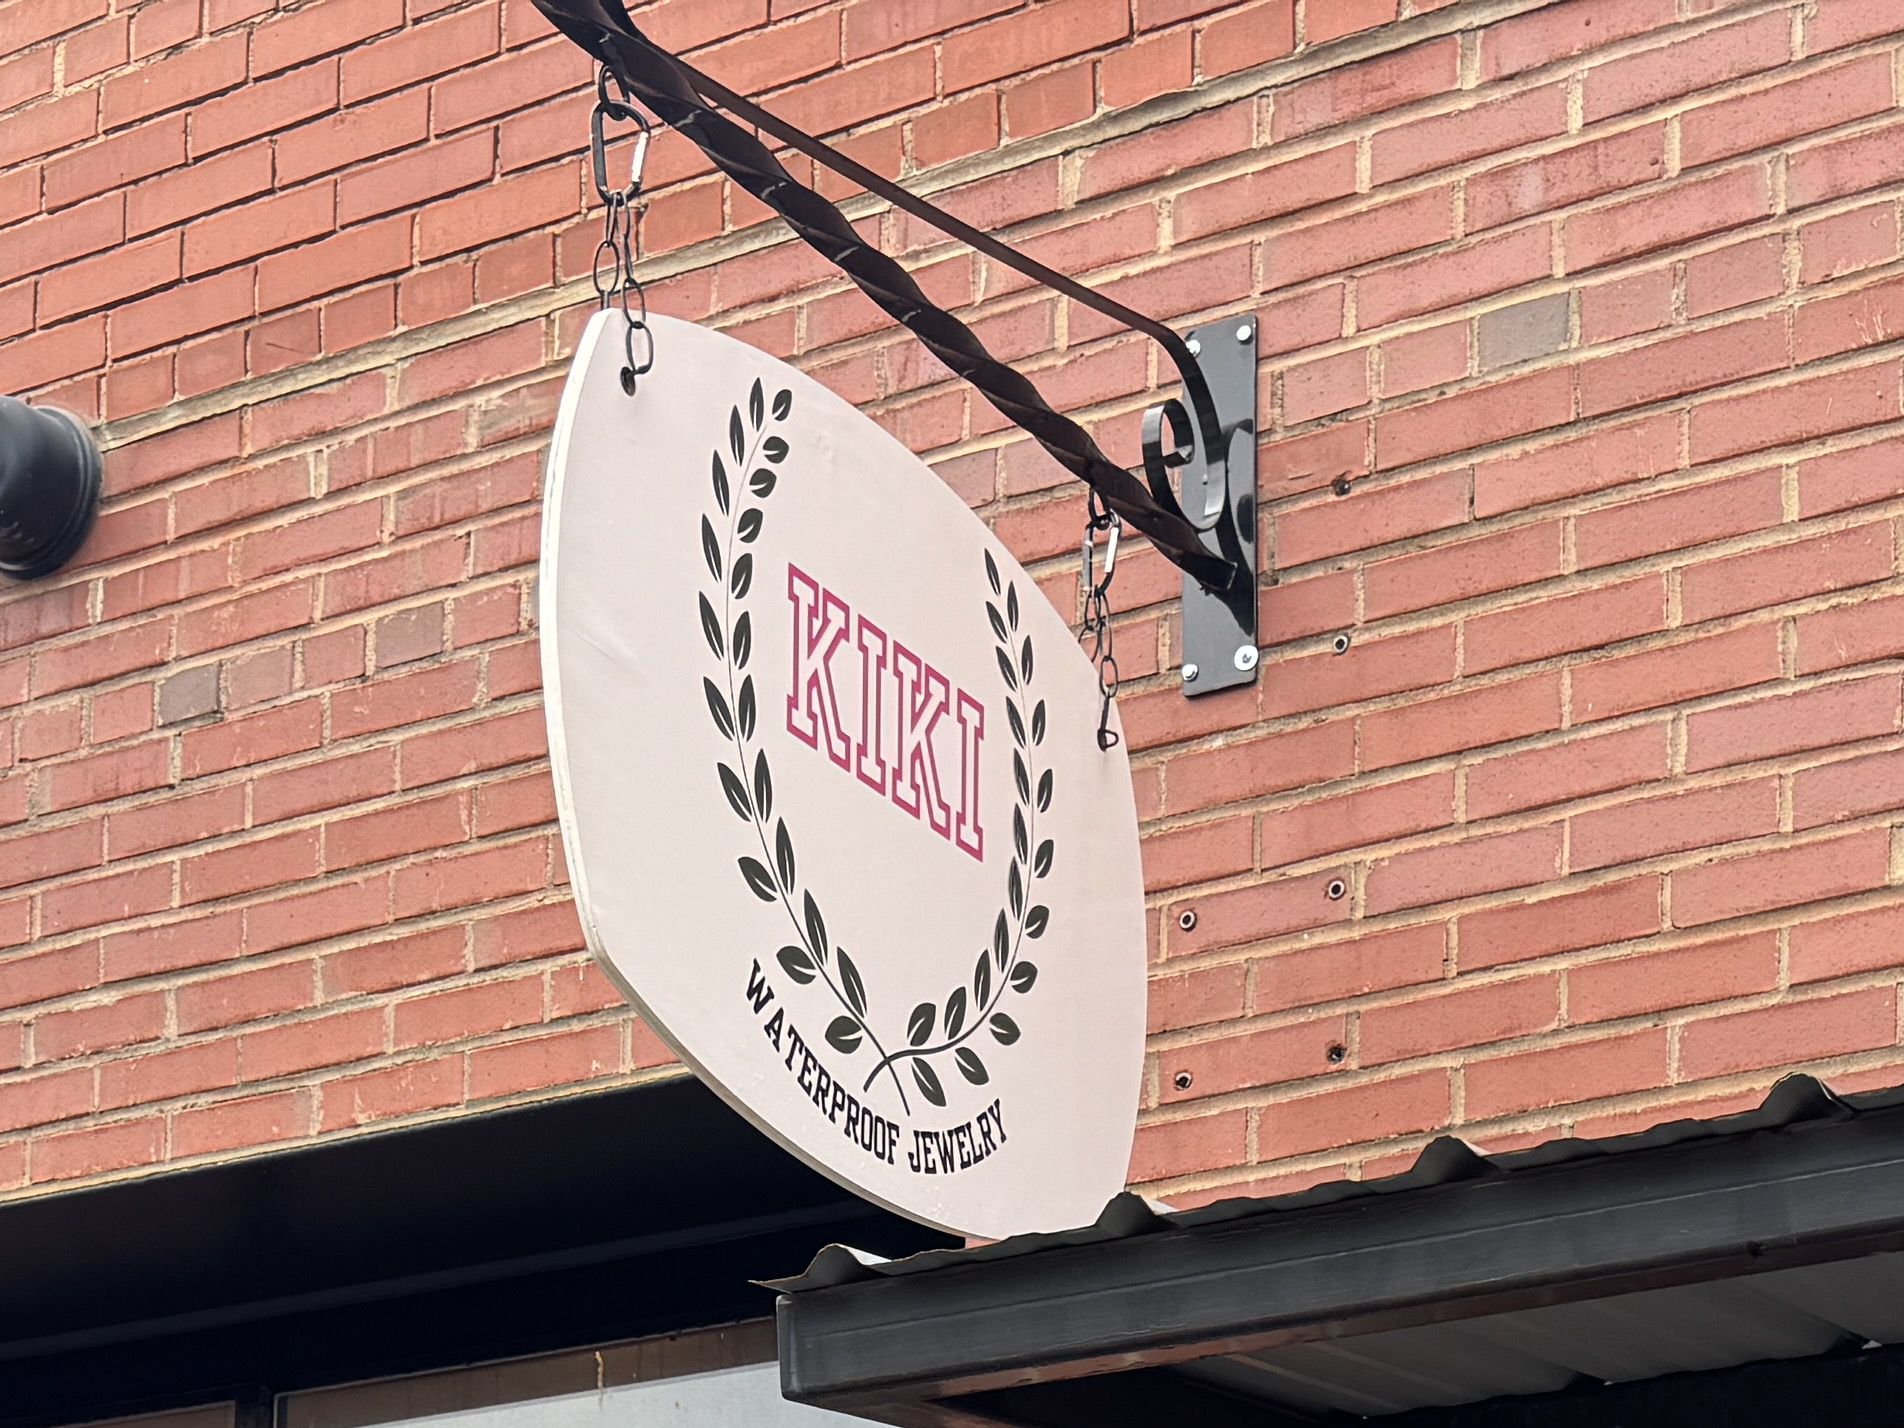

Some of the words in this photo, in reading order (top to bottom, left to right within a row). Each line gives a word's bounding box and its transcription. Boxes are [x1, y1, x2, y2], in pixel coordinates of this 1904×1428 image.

[787, 561, 985, 863] KIKI
[745, 956, 900, 1166] WATERPROOF
[907, 1097, 1008, 1175] JEWELRY
